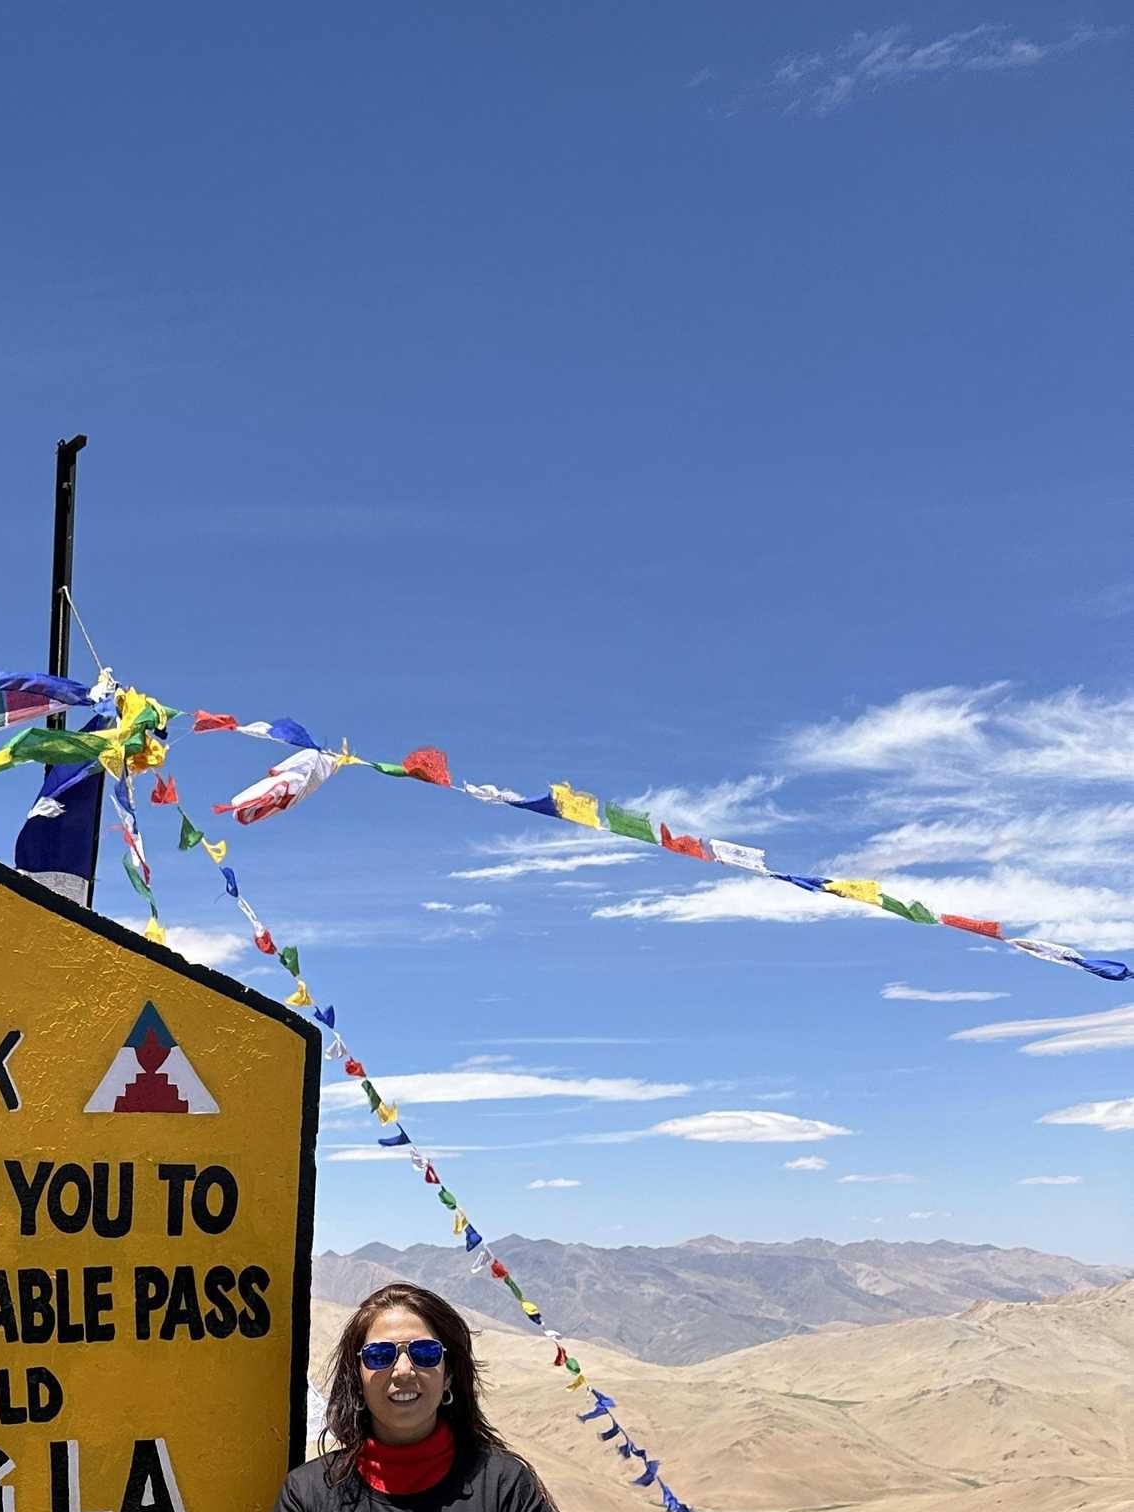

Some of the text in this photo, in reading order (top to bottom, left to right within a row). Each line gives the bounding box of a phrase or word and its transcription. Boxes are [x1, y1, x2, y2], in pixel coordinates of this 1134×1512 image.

[4, 1159, 134, 1239] YOU
[158, 1163, 239, 1236] TO
[134, 1264, 271, 1341] PASS
